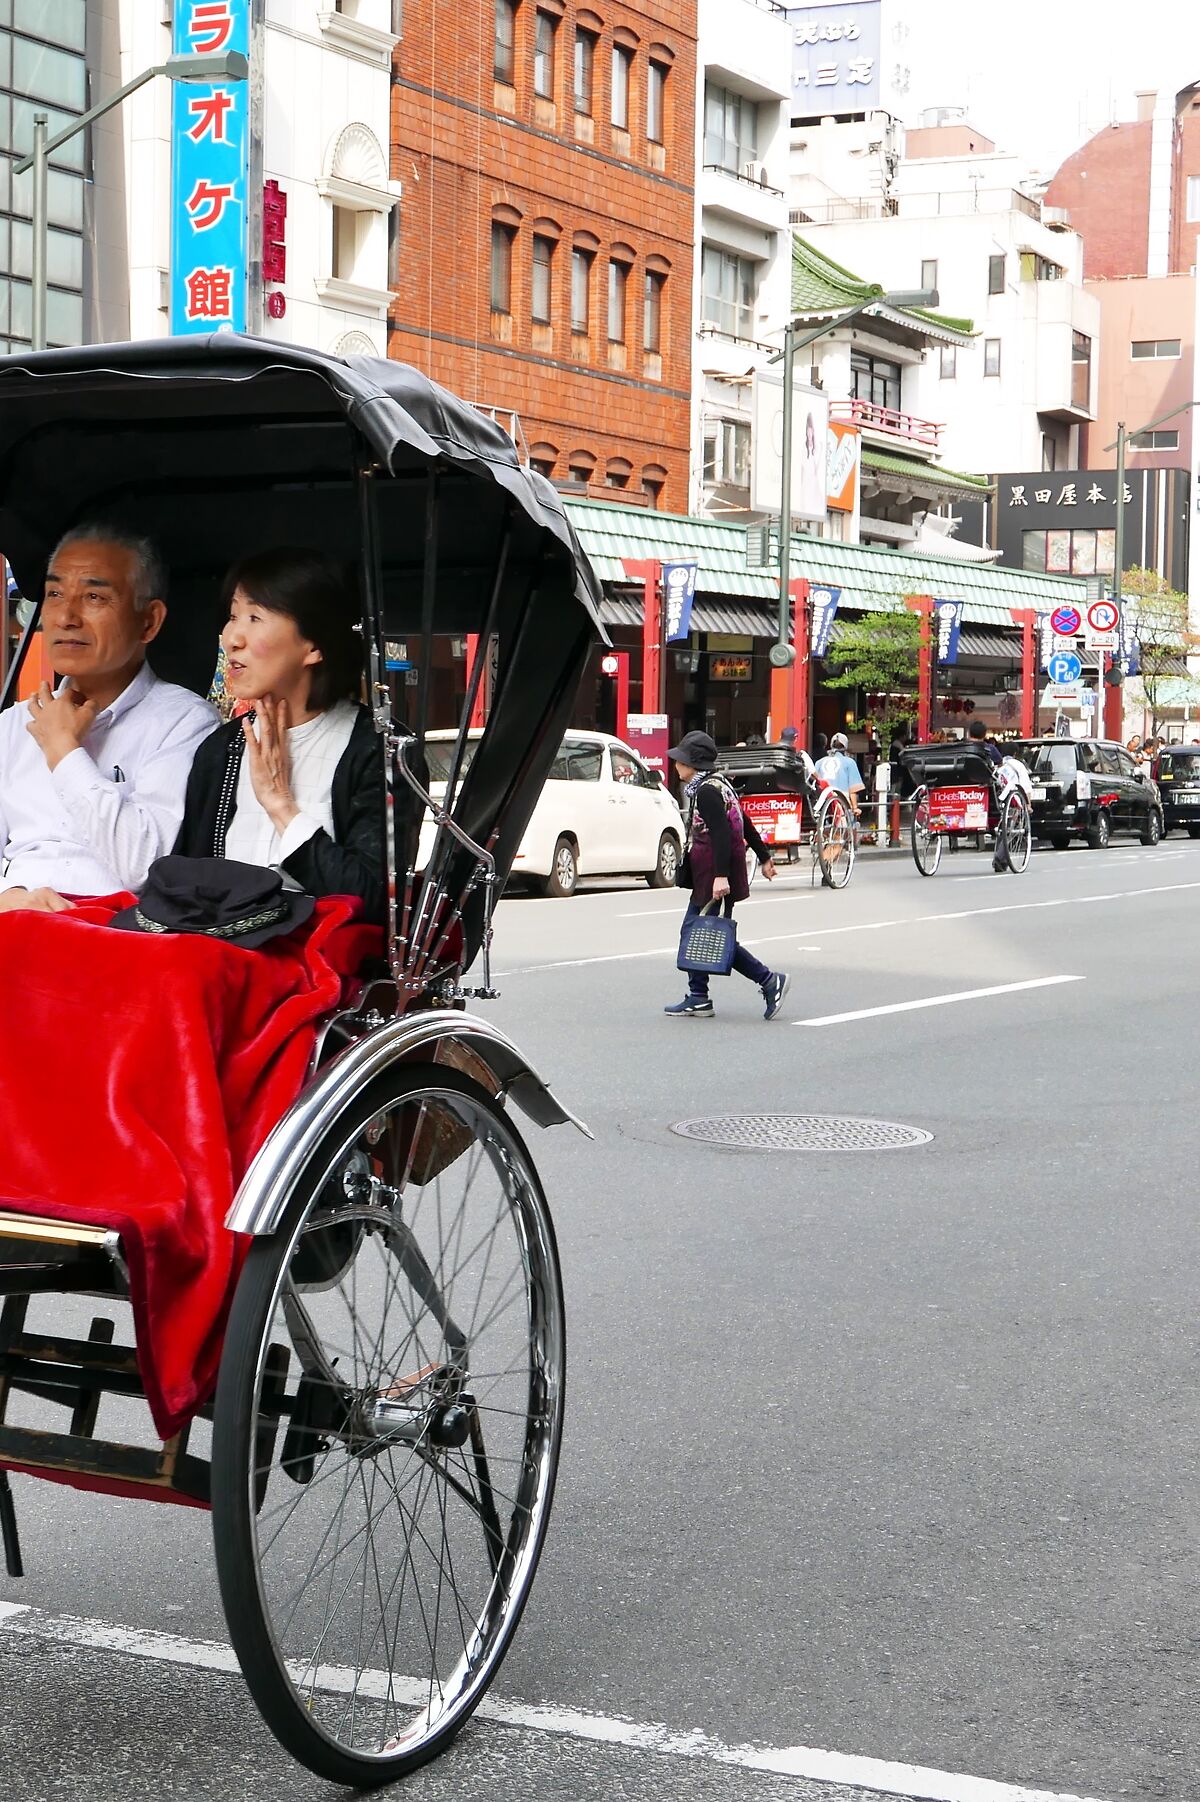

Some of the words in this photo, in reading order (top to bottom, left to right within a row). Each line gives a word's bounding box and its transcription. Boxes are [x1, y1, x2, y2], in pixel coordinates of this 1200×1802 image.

[794, 19, 861, 45] 天ぷら
[815, 56, 875, 87] 三定
[186, 3, 233, 320] ラオケ館
[1009, 482, 1133, 507] 黒田屋本店
[1055, 660, 1069, 681] P
